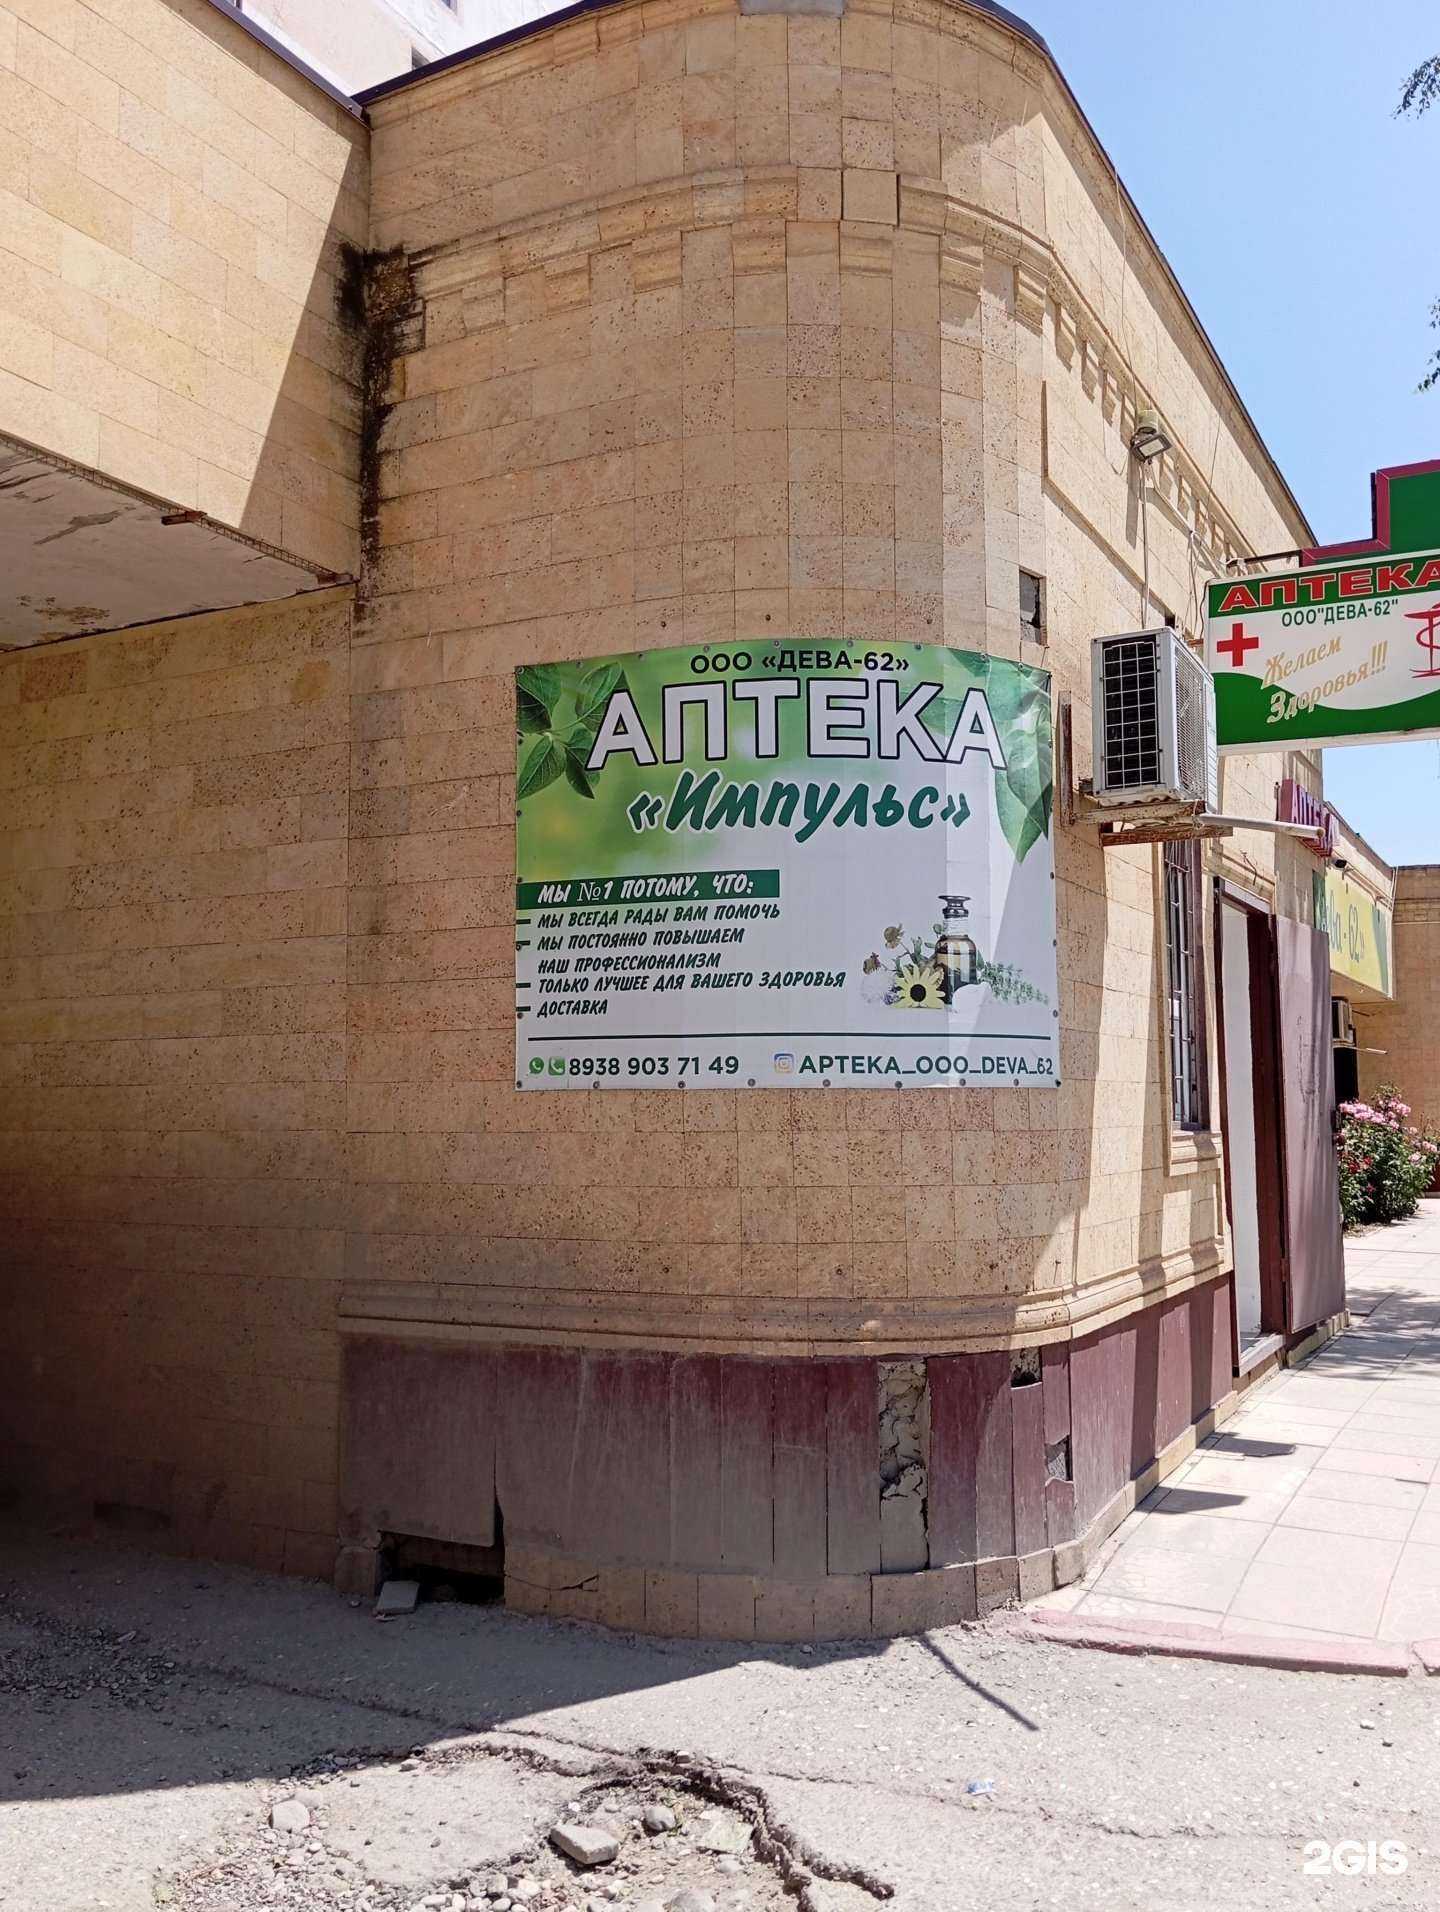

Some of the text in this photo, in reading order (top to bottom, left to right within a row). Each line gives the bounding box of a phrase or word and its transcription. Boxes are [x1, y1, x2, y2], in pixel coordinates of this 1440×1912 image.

[1217, 558, 1440, 613] АПТЕКА
[690, 649, 909, 674] ООО «ДЕВА-62»
[1260, 635, 1342, 690] Желаем
[1266, 640, 1388, 724] Здоровья!!!
[585, 677, 1008, 771] АПТЕКА
[626, 768, 971, 843] «Импульс»
[538, 873, 754, 903] МЫ №1 ПОТОМУ, ЧТО:
[538, 902, 781, 929] МЫ ВСЕГДА РАДЫ ВАМ ПОМОЧЬ
[537, 927, 746, 951] МЫ ПОСТОЯННО ПОВЫШАЕМ
[538, 952, 722, 974] НАШ ПРОФЕССИОНАЛИЗМ
[539, 971, 847, 993] ТОЛЬКО ЛУЧШЕЕ ДЛЯ ВАШЕГО ЗДОРОВЬЯ
[537, 999, 609, 1018] ДОСТАВКА
[569, 1055, 740, 1075] 8938 903 71 49
[799, 1054, 1054, 1076] APTEKA_OOO_DEVA_62
